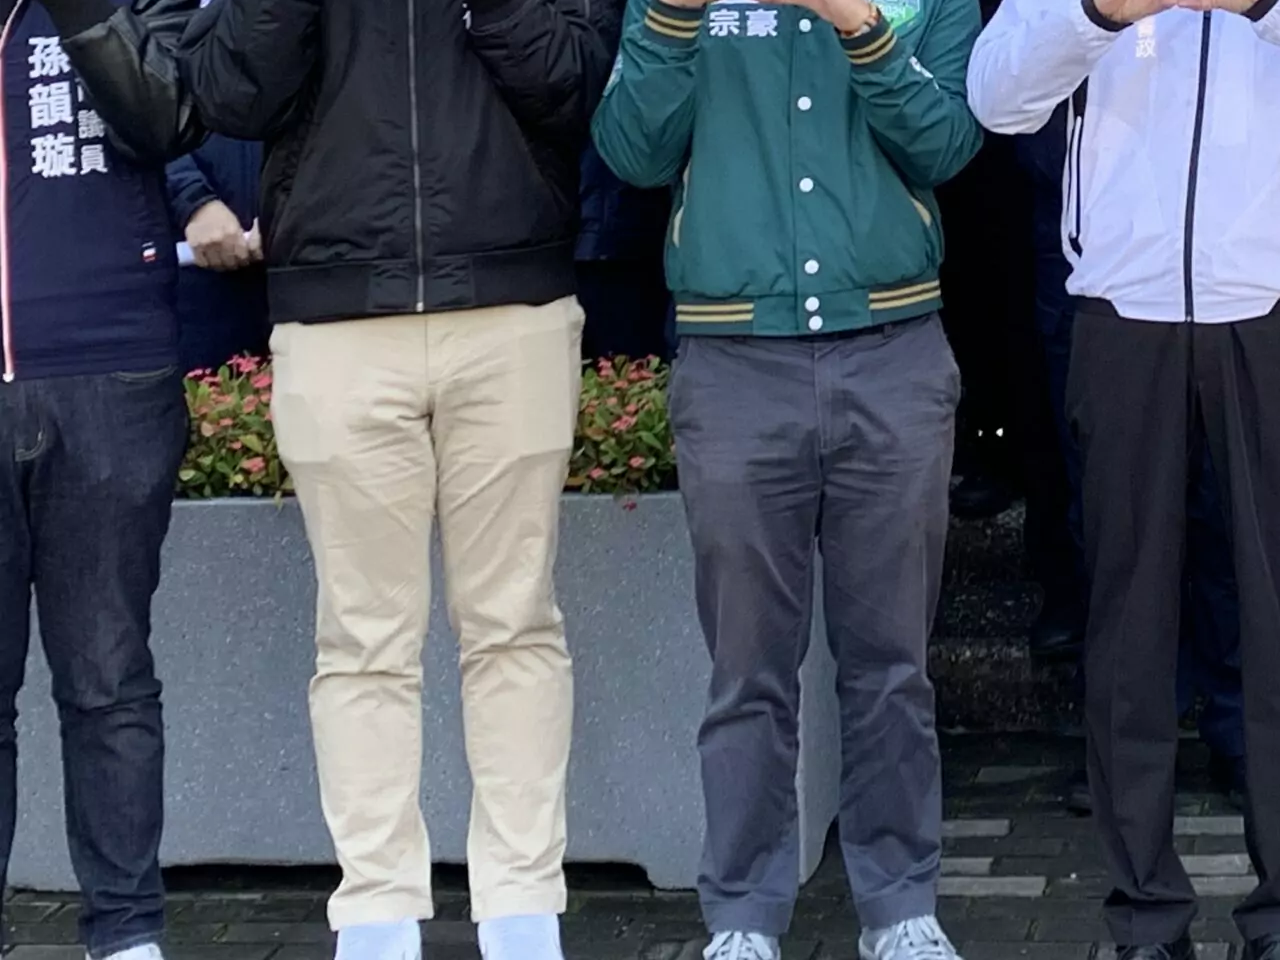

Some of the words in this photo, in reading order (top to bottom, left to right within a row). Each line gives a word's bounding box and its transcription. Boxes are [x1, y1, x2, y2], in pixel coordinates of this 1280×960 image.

[709, 8, 777, 37] 宗豪
[27, 36, 78, 178] 孫韻璇
